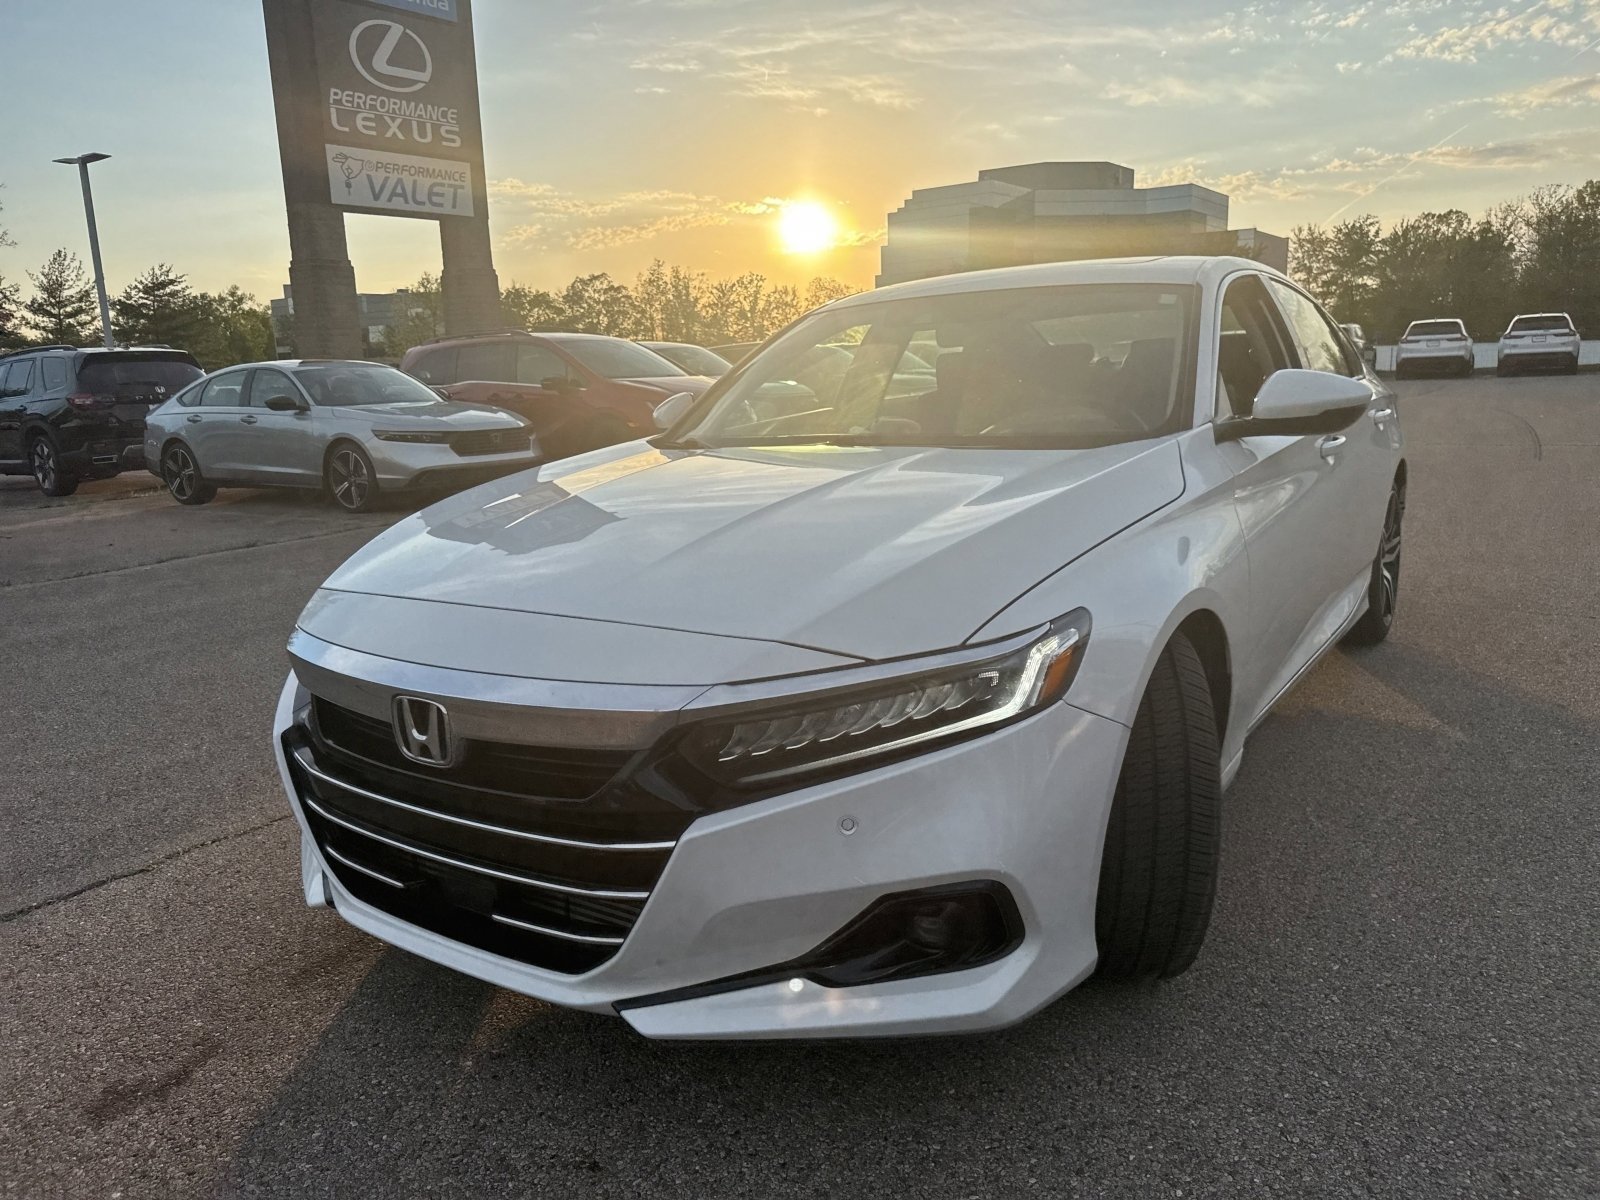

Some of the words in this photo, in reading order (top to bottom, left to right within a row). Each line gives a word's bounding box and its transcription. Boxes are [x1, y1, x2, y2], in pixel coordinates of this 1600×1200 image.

[329, 87, 458, 124] PERFORMANCE
[329, 107, 461, 148] LEXUS
[375, 161, 467, 183] PERFORMANCE
[365, 173, 465, 210] VALET
